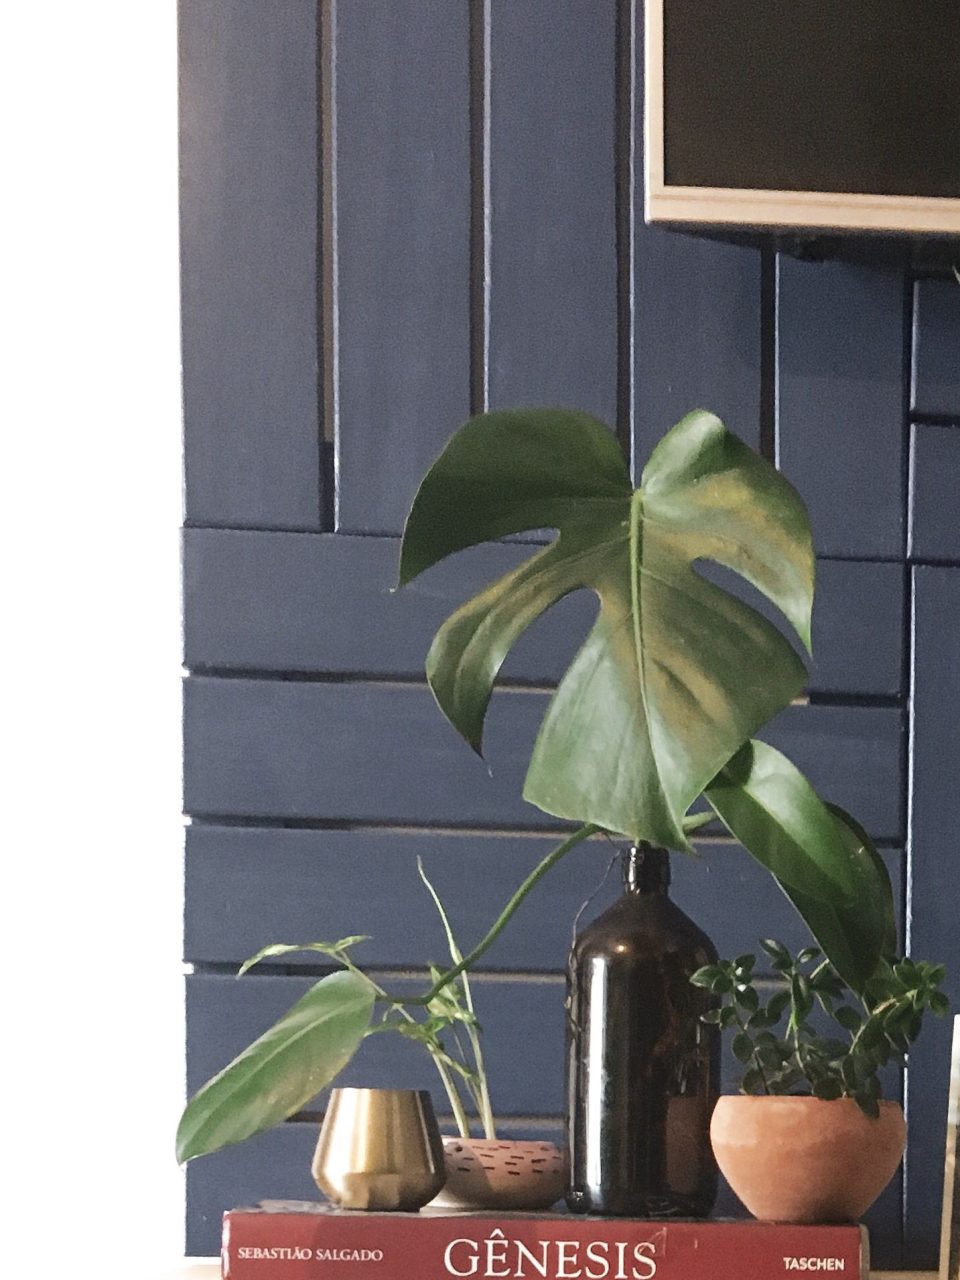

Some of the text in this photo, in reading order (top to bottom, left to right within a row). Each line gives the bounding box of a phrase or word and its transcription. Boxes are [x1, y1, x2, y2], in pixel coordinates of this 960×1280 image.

[238, 1247, 383, 1262] SEBASTIÃO SALGADO
[443, 1228, 657, 1280] GÊNESIS
[783, 1257, 845, 1271] TASCHEN
